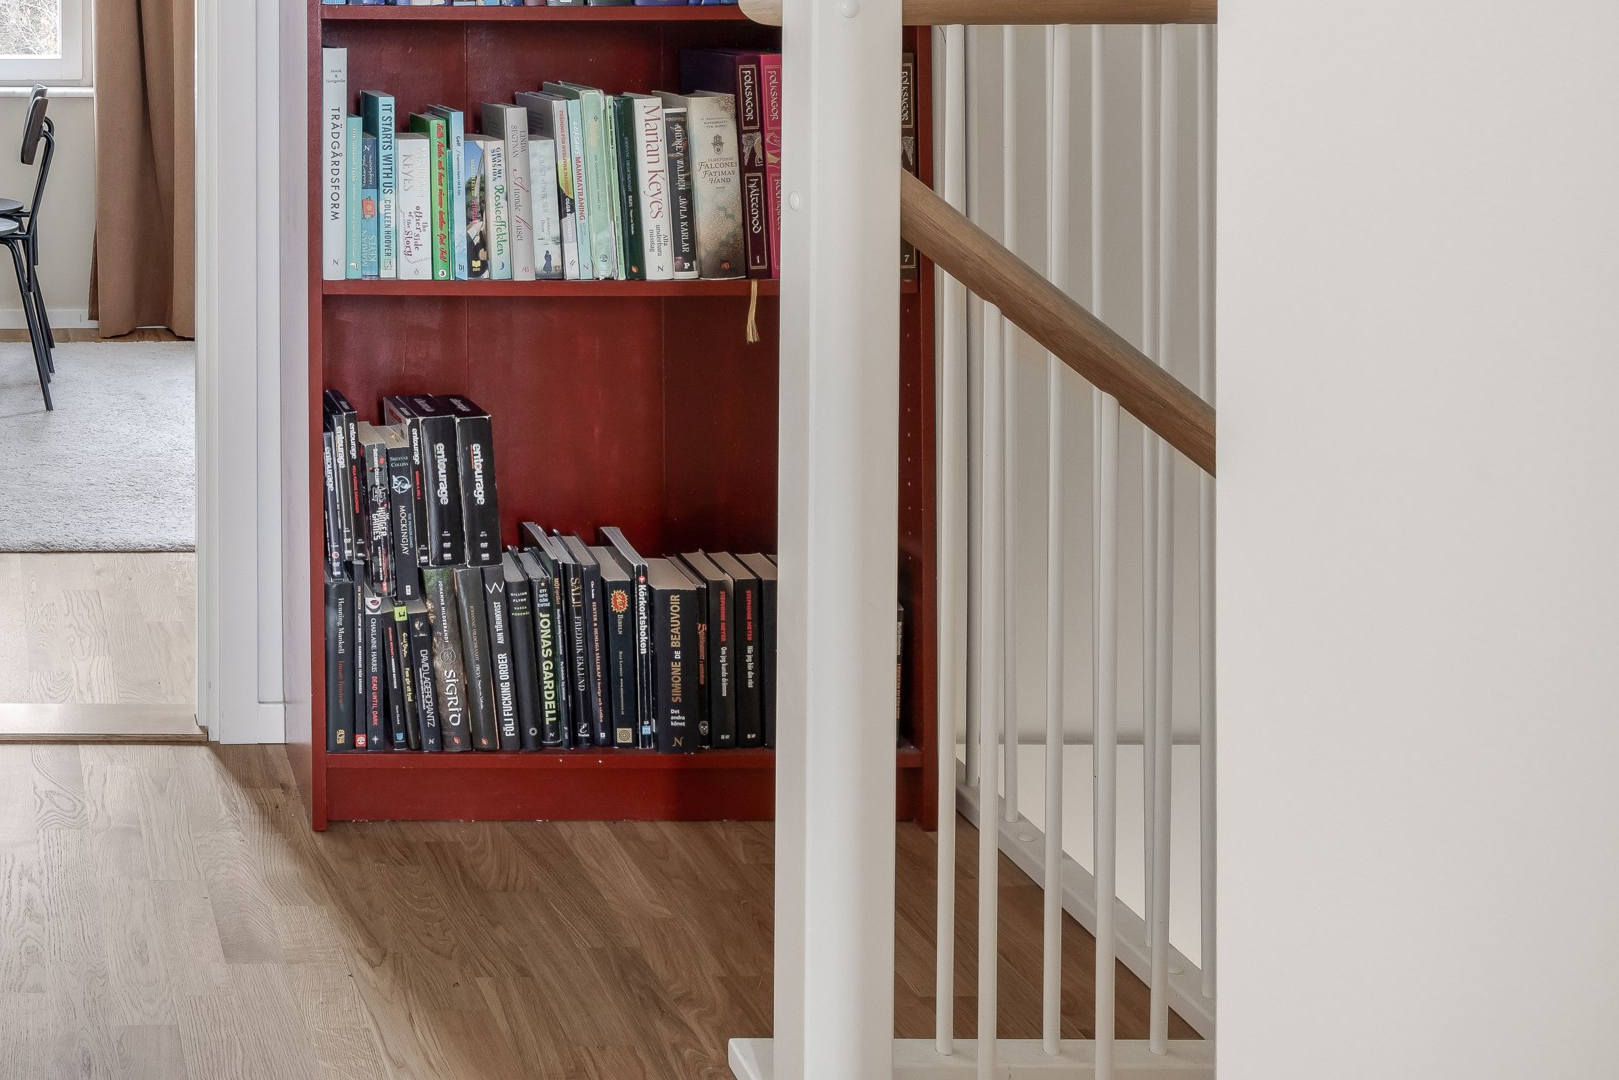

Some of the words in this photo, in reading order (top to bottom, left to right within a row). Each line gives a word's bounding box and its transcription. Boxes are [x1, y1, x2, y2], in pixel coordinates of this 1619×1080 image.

[382, 104, 392, 112] IT
[743, 70, 754, 121] FOLKSAGOR
[768, 69, 779, 121] FOLKSAGOR
[382, 115, 392, 150] STARTS
[519, 131, 527, 153] LINDA
[643, 105, 663, 165] Marian
[330, 106, 342, 221] TRÄDGÅRDSFORM
[383, 153, 393, 179] WITH
[402, 153, 414, 192] KEYES
[383, 182, 393, 195] US
[643, 169, 665, 220] Keyes
[384, 200, 392, 229] COLLEEN
[414, 206, 423, 232] other
[678, 195, 689, 219] JÄVLA
[384, 230, 392, 257] HOOVER
[403, 230, 414, 258] Story
[413, 232, 421, 251] side
[648, 229, 656, 252] misstag
[680, 221, 690, 252] KARLAR
[904, 254, 910, 262] 7
[336, 426, 345, 469] entourage
[349, 422, 358, 459] entourage
[412, 428, 421, 465] entourage
[325, 446, 335, 491] entourage
[436, 442, 449, 505] entourage
[473, 443, 485, 505] entourage
[372, 513, 380, 540] GAMES
[377, 507, 388, 536] HUNGER
[399, 505, 409, 555] MOCKINGJAY
[438, 580, 446, 606] JOHANNE
[571, 577, 582, 608] SÄLJ!
[337, 597, 345, 626] Henning
[440, 606, 450, 643] HILDEBRANDT
[493, 601, 503, 631] TÖRNKVIST
[639, 584, 648, 655] Körkortsboken
[670, 595, 682, 648] BEAUVOIR
[496, 631, 505, 644] ANN
[538, 612, 553, 658] JONAS
[574, 615, 585, 654] FREDRIK
[419, 649, 431, 671] DAVID
[497, 653, 511, 681] ORDER
[674, 650, 681, 659] DE
[576, 656, 586, 691] EKLUND
[671, 661, 682, 703] SIMONE
[422, 672, 436, 727] LAGERCRANTZ
[443, 669, 463, 727] SIGRID
[500, 682, 513, 716] FUCKING
[541, 660, 557, 724] GARDELL
[502, 718, 516, 737] FÖLJ
